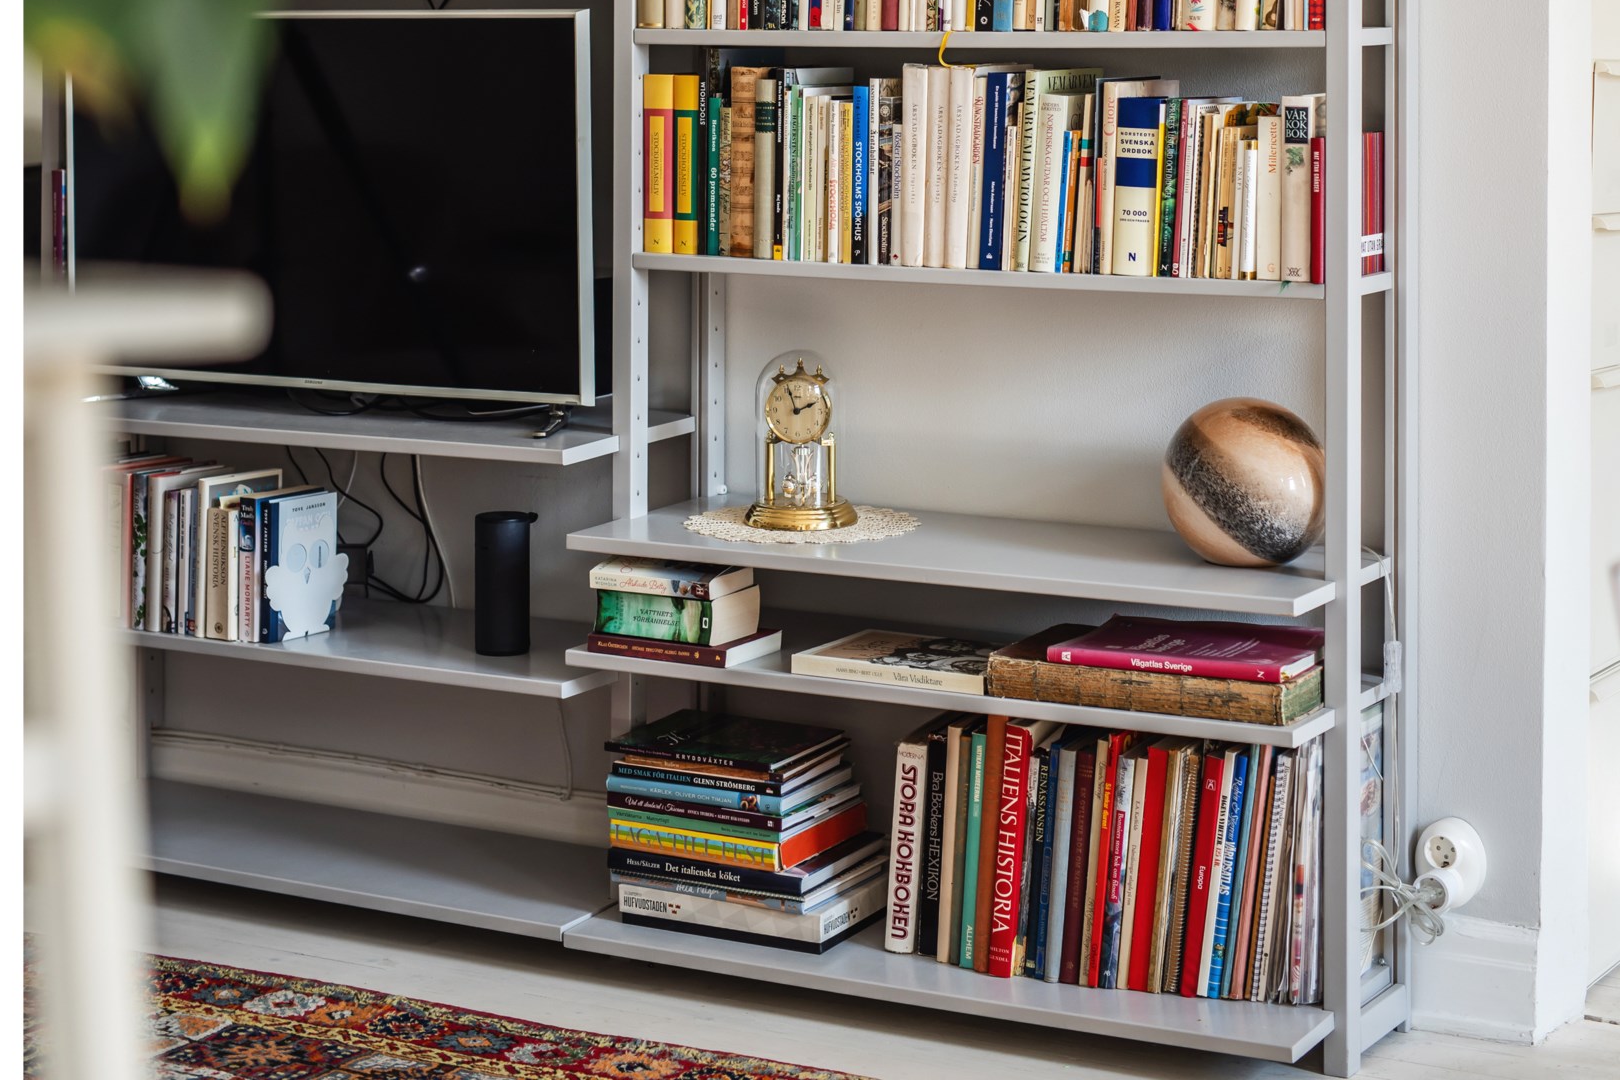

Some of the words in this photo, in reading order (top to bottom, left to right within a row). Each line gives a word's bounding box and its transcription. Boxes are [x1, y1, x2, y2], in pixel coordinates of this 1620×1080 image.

[1025, 79, 1035, 106] VEM
[1024, 111, 1036, 126] ÄR
[1286, 111, 1306, 120] VÅR
[1286, 120, 1306, 129] KOK
[1023, 127, 1034, 155] VEM
[1045, 114, 1053, 155] NORDISKA
[1286, 129, 1306, 138] BOK
[710, 167, 717, 179] 60
[893, 160, 901, 199] Stockholm
[1043, 156, 1051, 185] GUDAR
[708, 180, 717, 231] promenader
[1018, 166, 1031, 242] MYTOLOGIN
[1042, 187, 1050, 207] OCH
[854, 201, 863, 241] SPÖKHUS
[1040, 208, 1049, 242] HJÄLTAR
[1130, 657, 1162, 670] Vågatlas
[1164, 661, 1192, 673] Sverige
[676, 753, 734, 766] KRYDDVÄXTER
[618, 767, 632, 776] MED
[634, 768, 651, 778] SMAK
[652, 770, 665, 780] FÖR
[666, 773, 691, 783] ITALIEN
[693, 777, 713, 787] GLENN
[715, 779, 755, 792] STRÖMBERG
[899, 764, 918, 825] STORA
[932, 771, 944, 791] Bra
[999, 733, 1023, 825] ITALIENS
[929, 793, 943, 837] Böckers
[1035, 764, 1049, 842] RENÄSSANSEN
[613, 824, 663, 844] LAGA
[670, 834, 717, 859] TILL
[721, 841, 772, 867] FEST
[665, 863, 679, 874] Det
[681, 866, 716, 879] italienska
[719, 869, 740, 882] köket
[926, 838, 940, 900] HEXIKON
[992, 830, 1016, 933] HISTORIA
[1197, 866, 1206, 889] Europa
[1219, 841, 1236, 895] VÄRLDSATLAS
[891, 831, 915, 940] KOKBOKEN
[623, 896, 667, 913] HUFVUDSTADEN
[965, 925, 973, 959] ALLHEM
